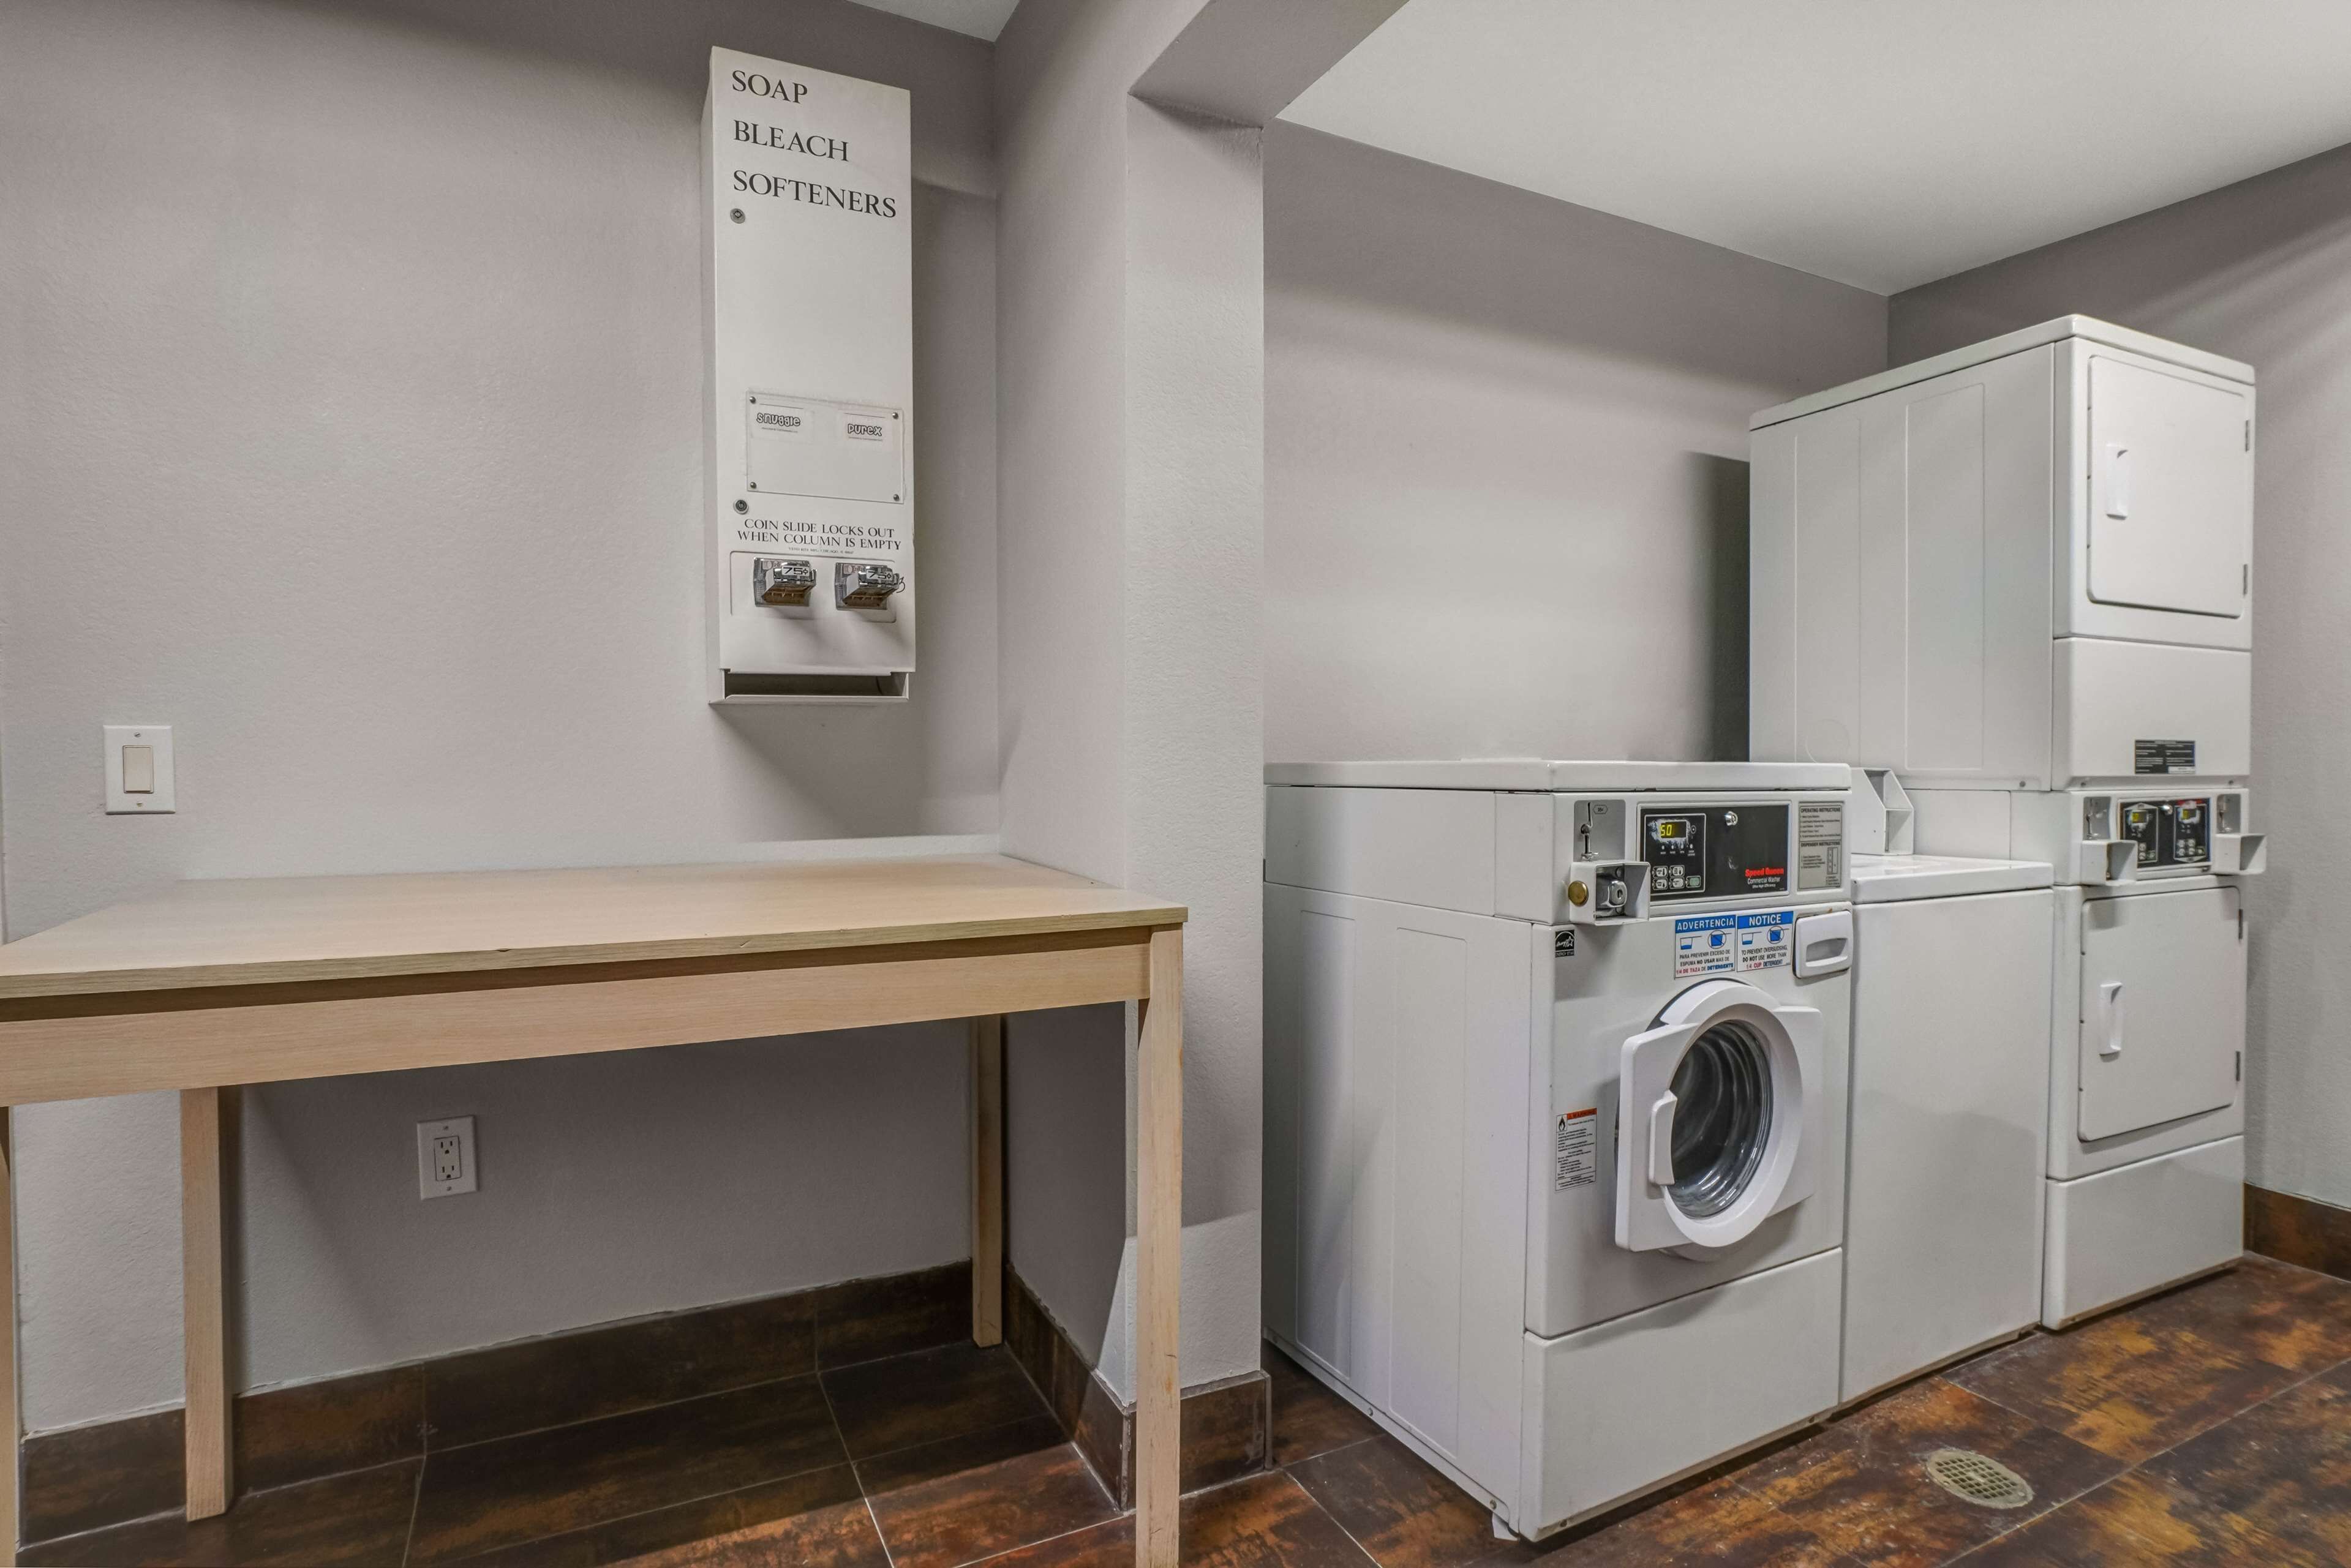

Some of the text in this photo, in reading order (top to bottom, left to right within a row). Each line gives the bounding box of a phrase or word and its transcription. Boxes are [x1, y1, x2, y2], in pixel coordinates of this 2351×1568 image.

[732, 70, 808, 104] SOAP
[733, 119, 849, 162] BLEACH
[733, 170, 897, 218] SOFTENERS
[744, 519, 895, 538] COIN SLIDE LOCKS OUT
[737, 530, 779, 542] WHEN
[784, 533, 840, 546] COLUMN
[845, 538, 855, 547] IS
[860, 539, 901, 550] EMPTY
[868, 571, 892, 579] 75¢
[1745, 867, 1784, 878] Speed Queen
[1677, 918, 1734, 931] ADVERTENCIA
[1749, 914, 1781, 926] NOTICE
